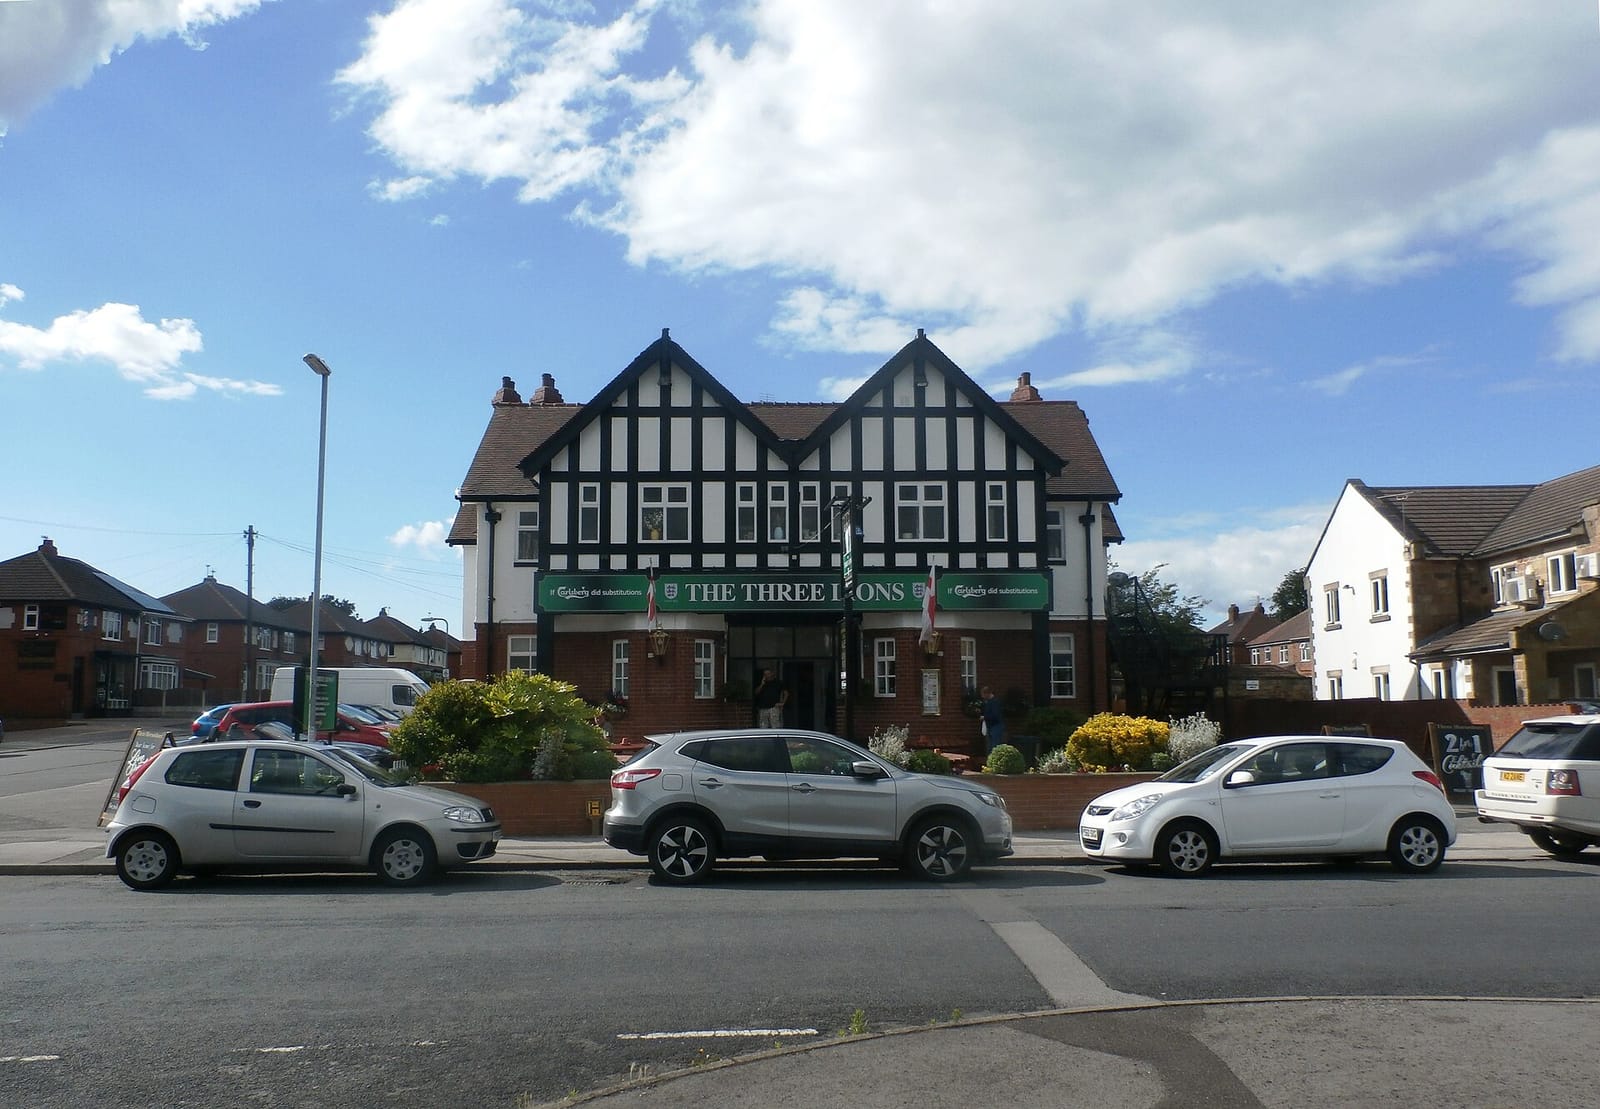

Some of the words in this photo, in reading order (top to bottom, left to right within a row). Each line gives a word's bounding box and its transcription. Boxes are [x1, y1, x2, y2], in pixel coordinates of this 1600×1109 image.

[557, 586, 590, 599] Carlsberg
[591, 588, 601, 596] did
[602, 588, 642, 596] substitutions
[685, 583, 737, 602] THE
[741, 583, 825, 602] THREE
[831, 582, 905, 602] LONS
[954, 584, 986, 598] Carlsberg
[987, 587, 998, 595] did
[999, 587, 1038, 595] substitutions
[1444, 733, 1459, 752] 2
[1472, 734, 1482, 753] 1
